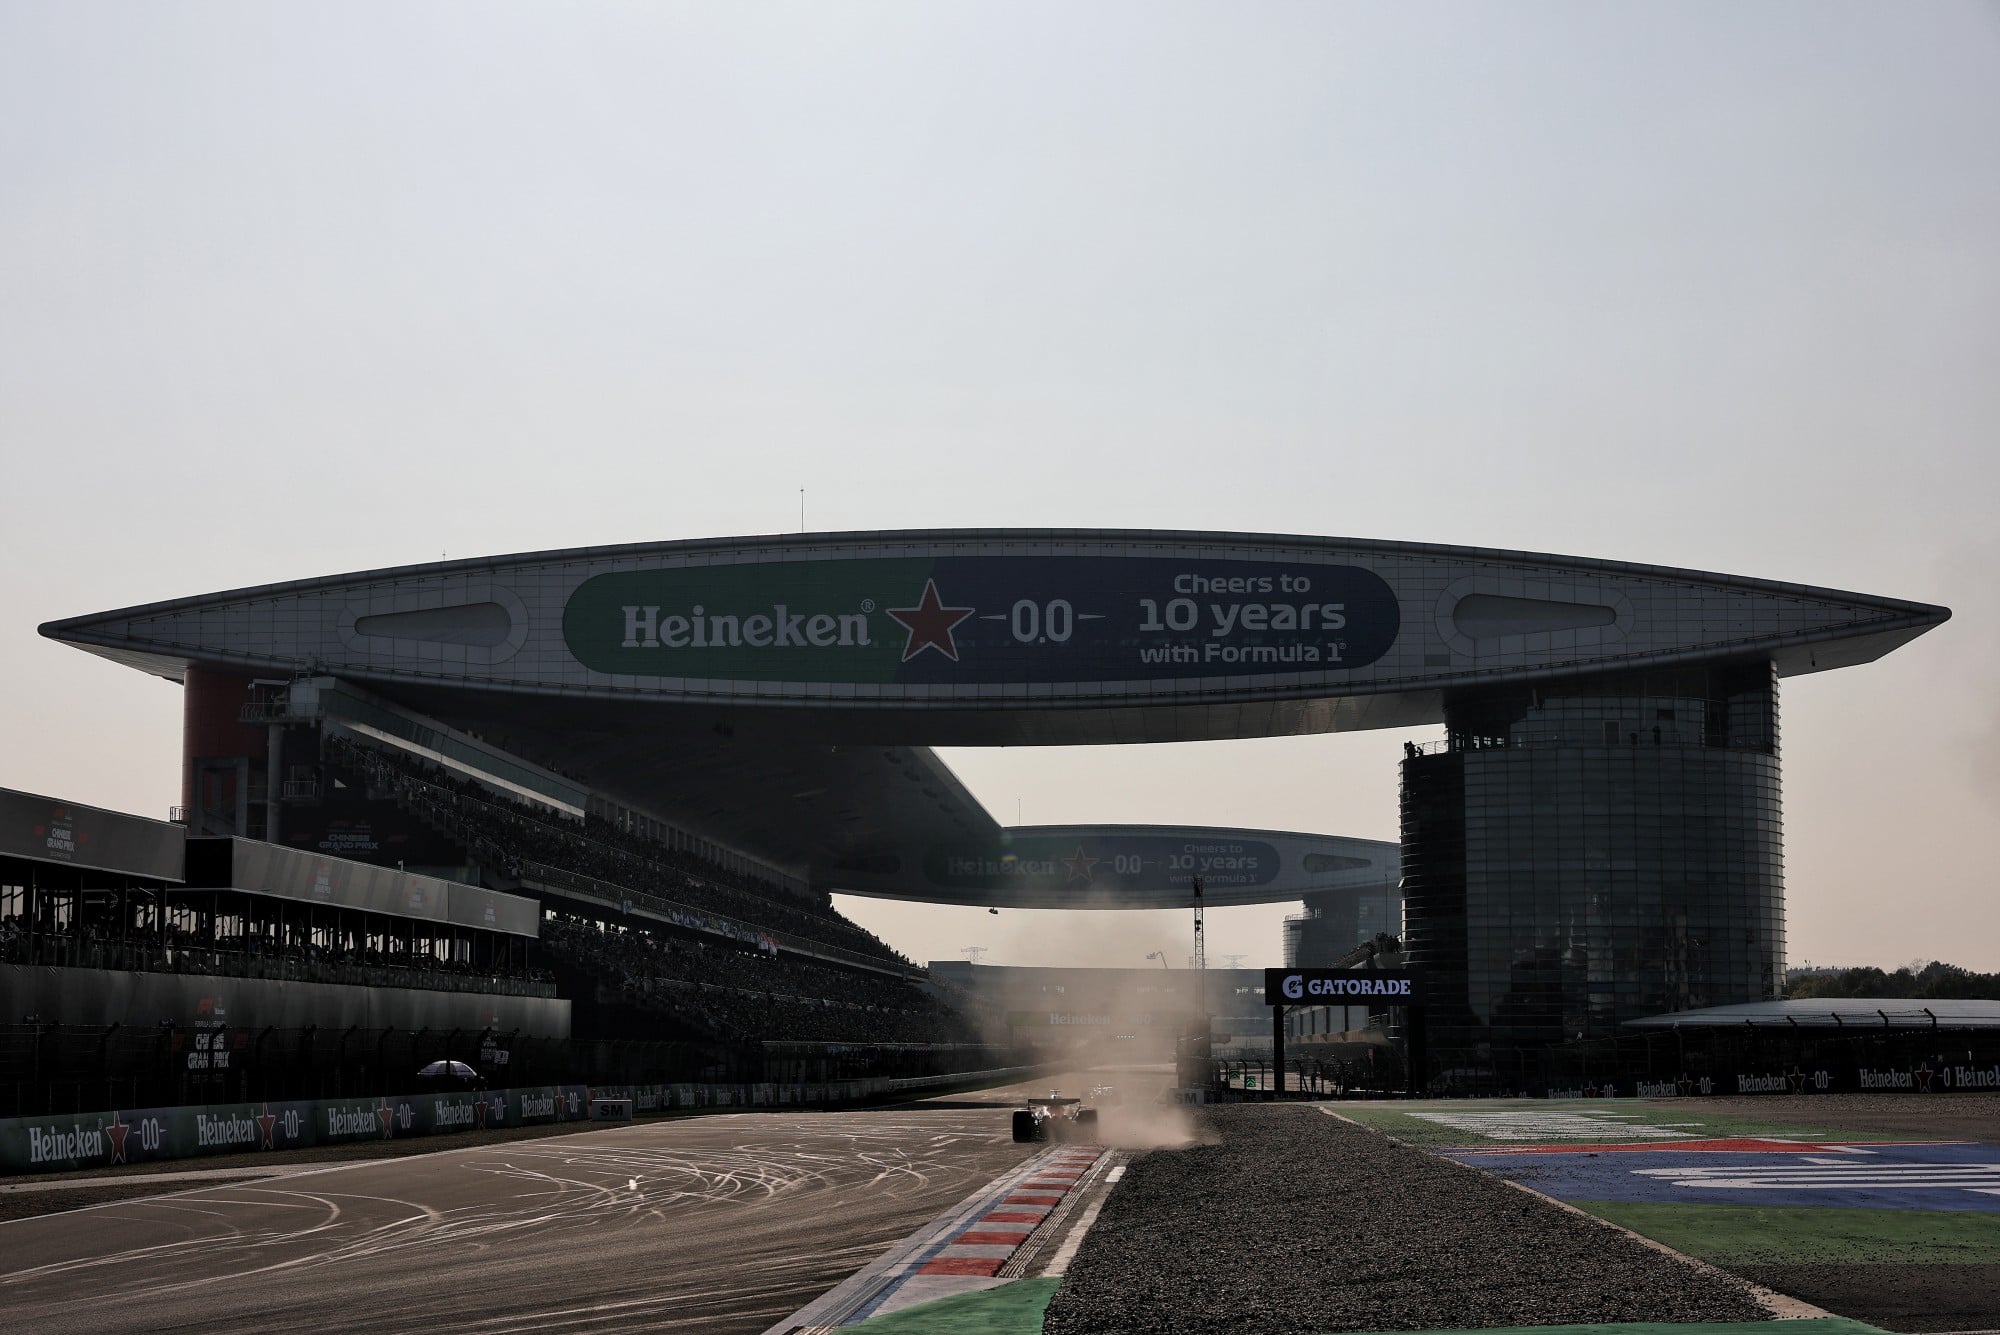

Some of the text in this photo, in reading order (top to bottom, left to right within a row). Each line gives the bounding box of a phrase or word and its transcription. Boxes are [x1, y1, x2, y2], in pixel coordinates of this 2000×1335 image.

[1174, 575, 1312, 593] Cheers to
[1010, 599, 1073, 643] 0.0
[1139, 599, 1347, 637] 10 years
[1139, 644, 1199, 663] with
[1206, 643, 1320, 663] Formula
[328, 834, 370, 842] CHINESE
[1183, 845, 1243, 854] Cheers to
[1169, 855, 1258, 871] 10 years
[1308, 979, 1411, 995] GATORADE
[1738, 1073, 1787, 1092] Heineken
[1862, 1068, 1913, 1088] Heineken
[1174, 1092, 1197, 1105] SM
[1636, 1080, 1677, 1098] Heineken
[435, 1099, 474, 1126] Heineken
[521, 1094, 555, 1118] Heineken
[600, 1105, 624, 1117] SM
[196, 1113, 255, 1146] Heineken
[328, 1106, 377, 1136] Heineken
[30, 1124, 104, 1163] Heineken
